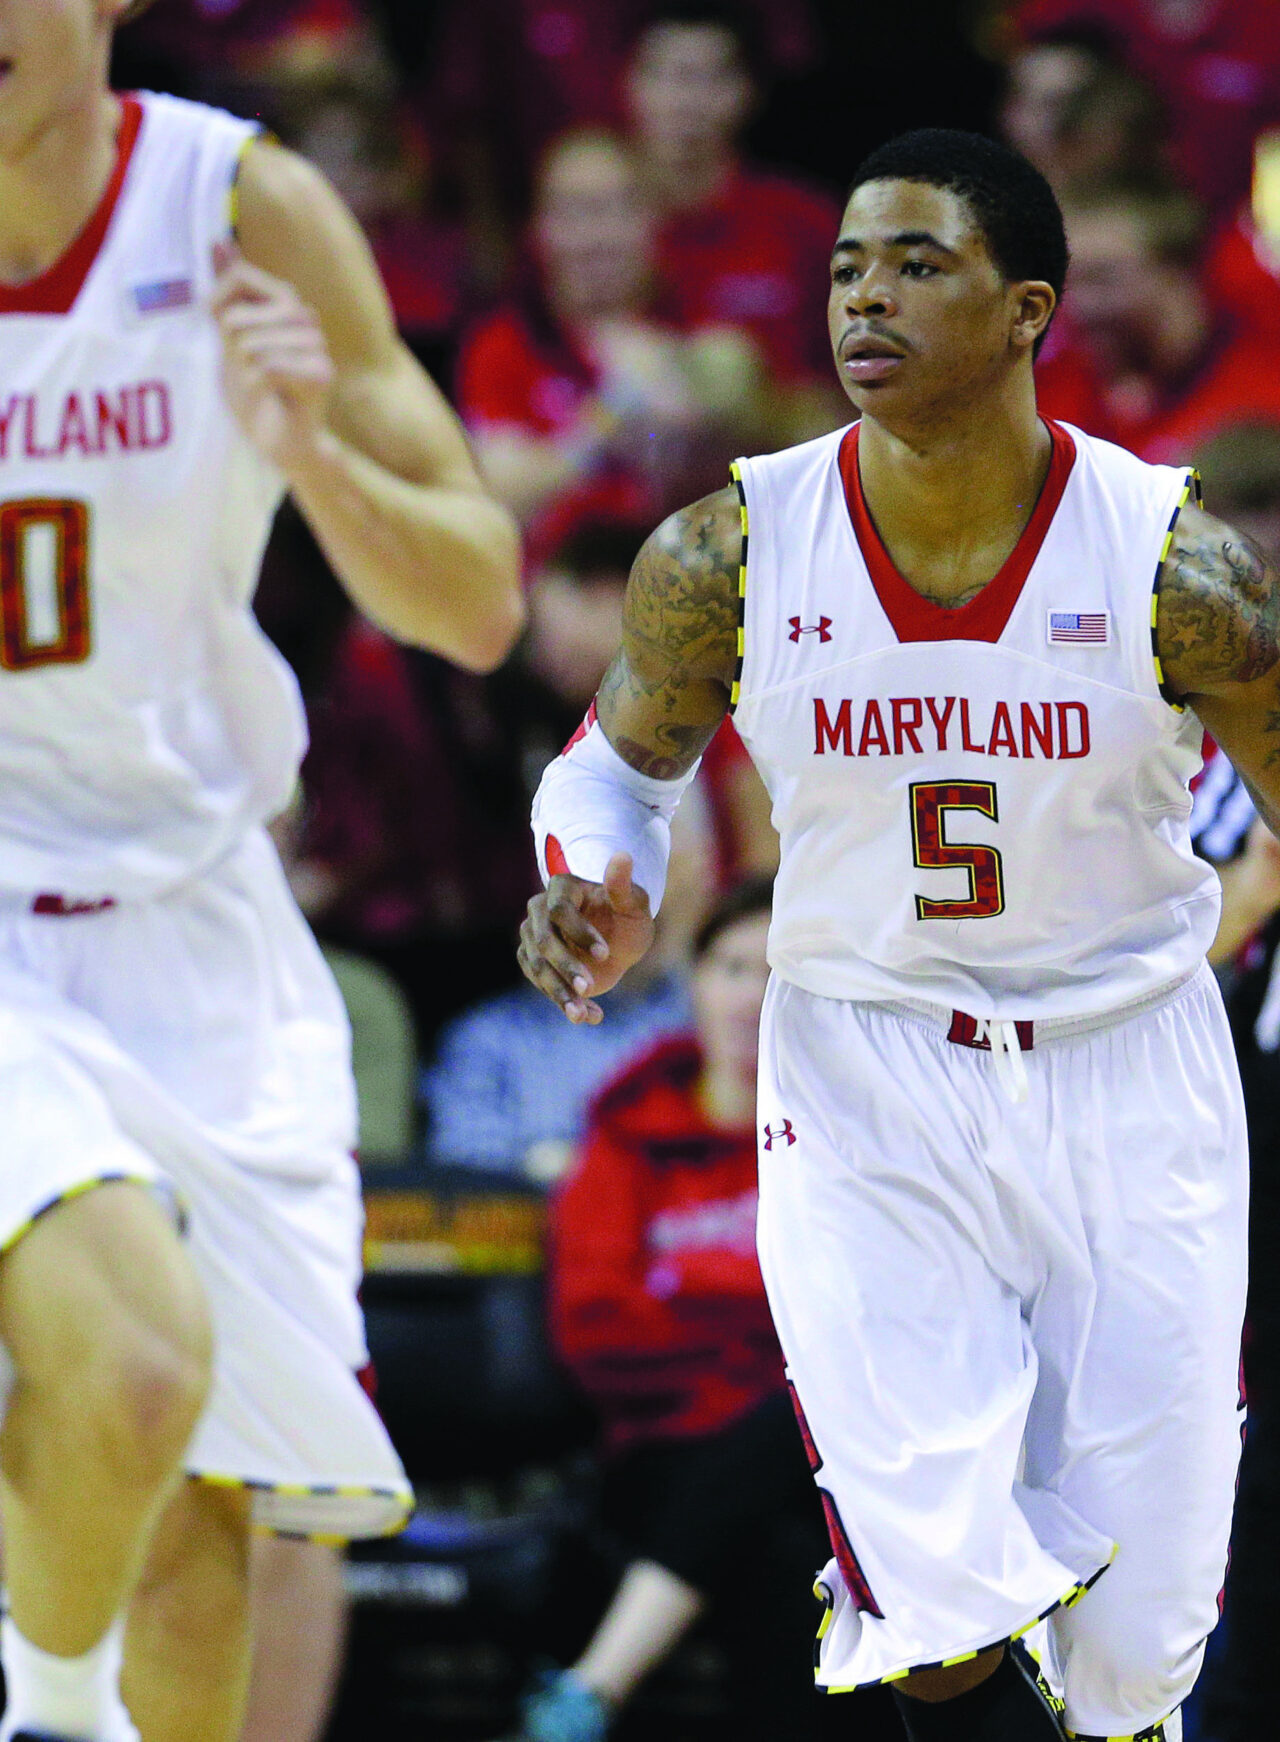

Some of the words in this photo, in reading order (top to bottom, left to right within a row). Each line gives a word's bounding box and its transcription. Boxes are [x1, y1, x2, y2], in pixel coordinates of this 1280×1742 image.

[0, 497, 92, 671] 0
[813, 696, 1090, 760] MARYLAND
[908, 778, 1005, 921] 5
